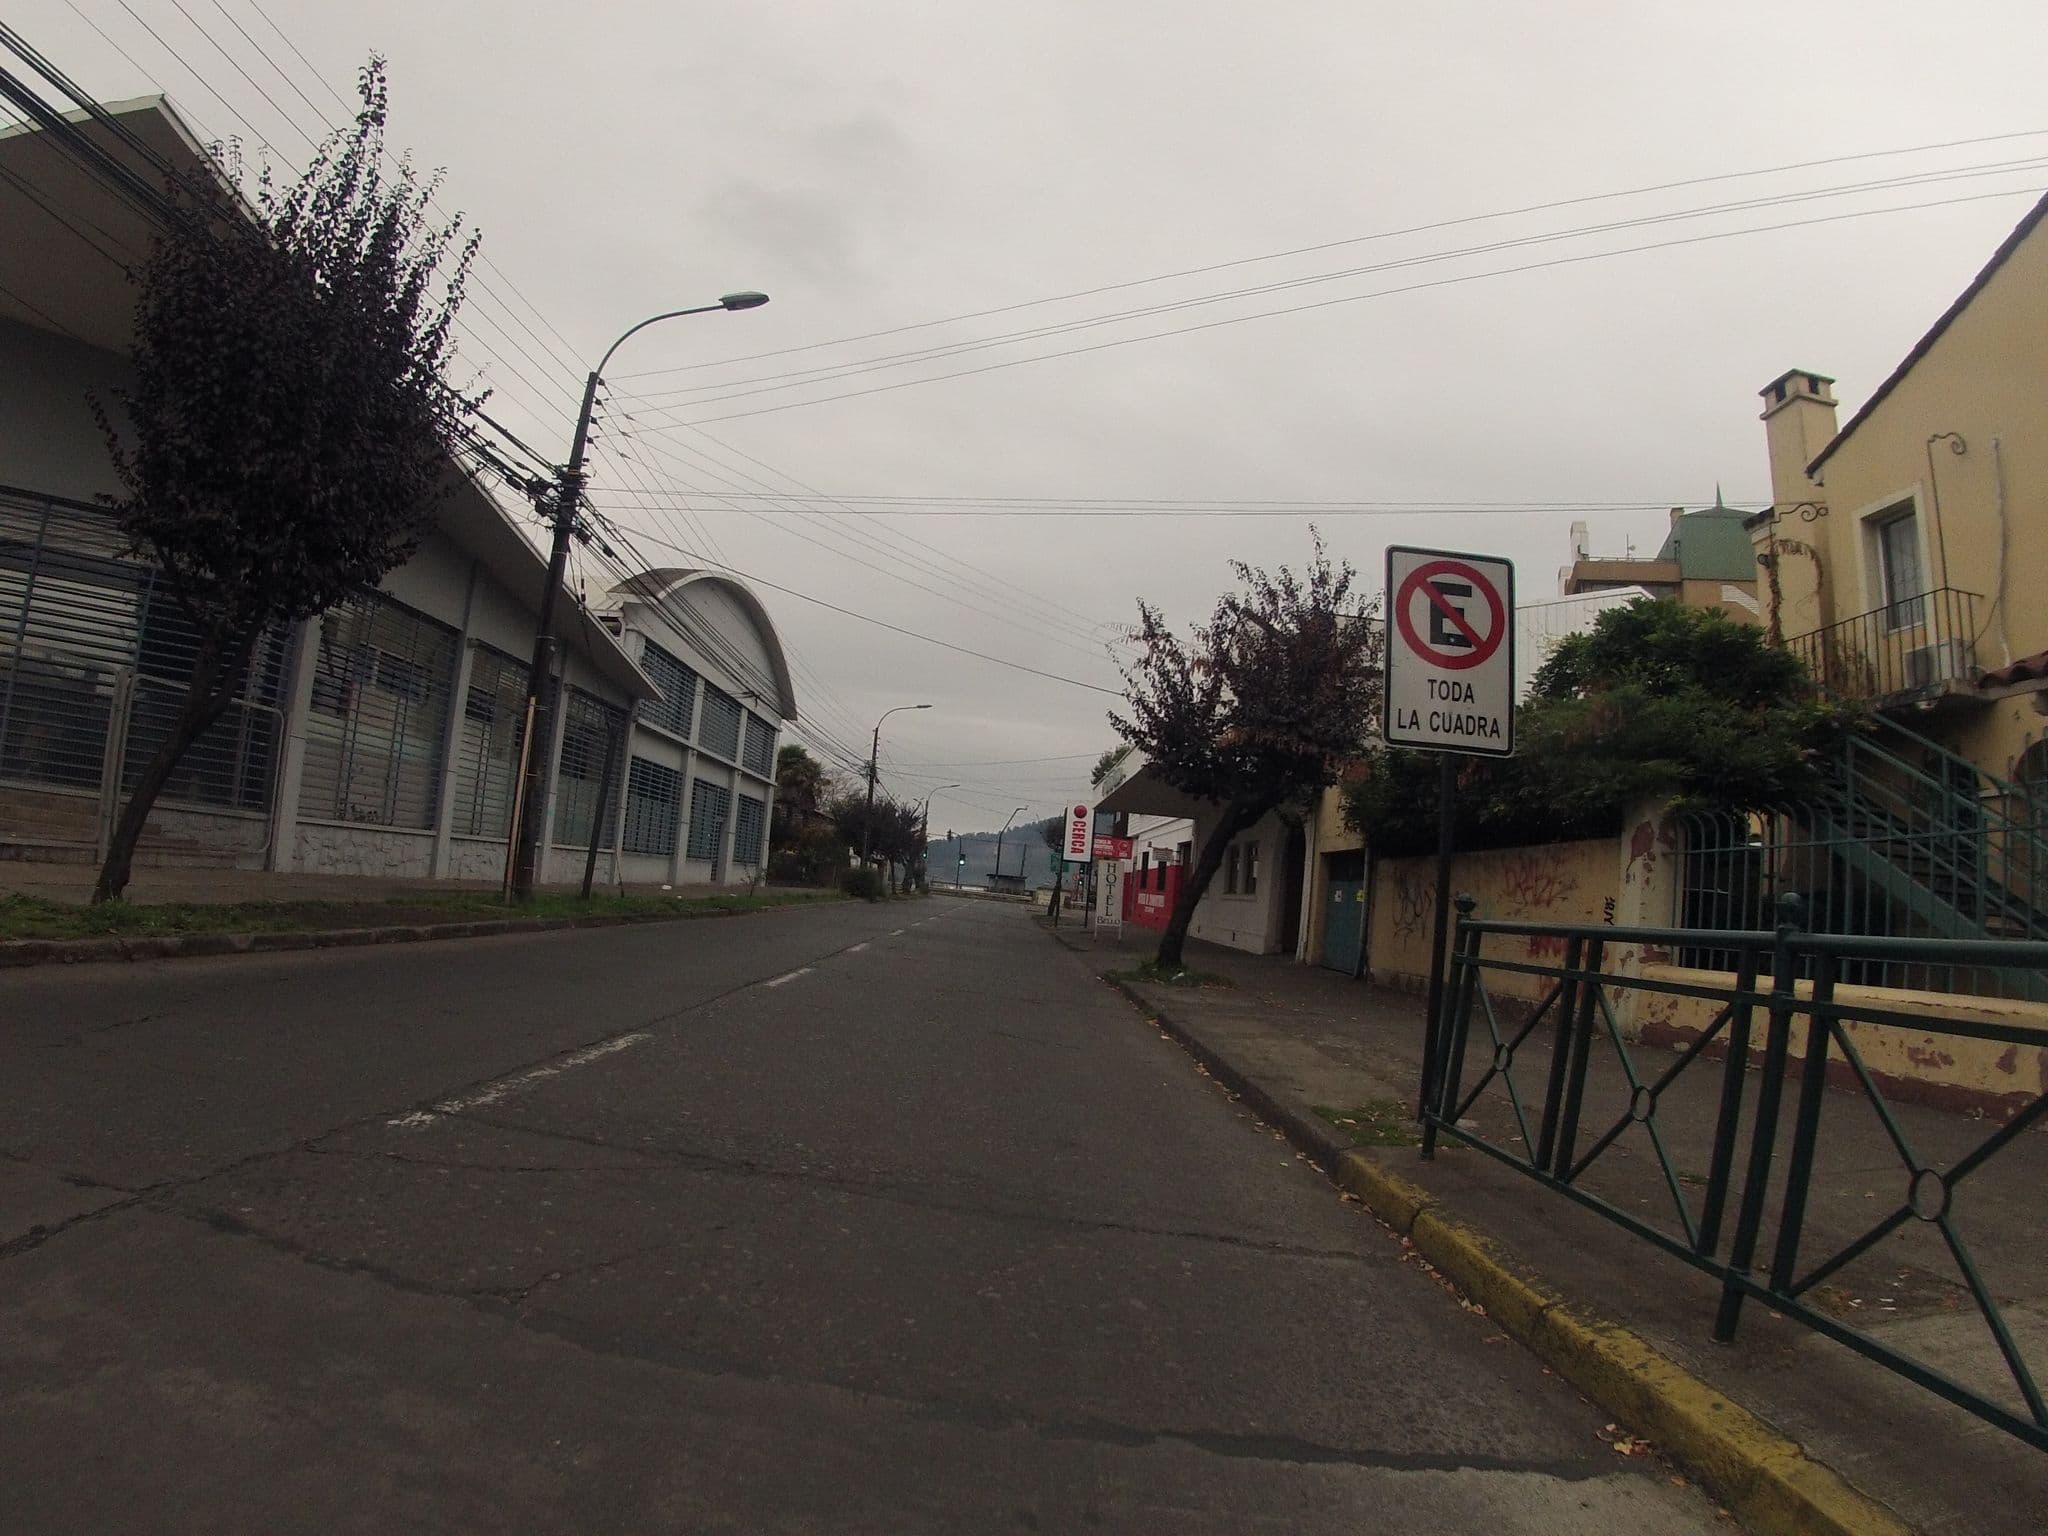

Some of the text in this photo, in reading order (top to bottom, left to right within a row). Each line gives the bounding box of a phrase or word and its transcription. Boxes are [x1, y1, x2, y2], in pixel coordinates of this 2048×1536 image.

[1427, 679, 1474, 704] TODA
[1397, 708, 1500, 738] LA CUADRA
[1070, 820, 1087, 854] CERCA
[1105, 862, 1117, 917] HOTEL
